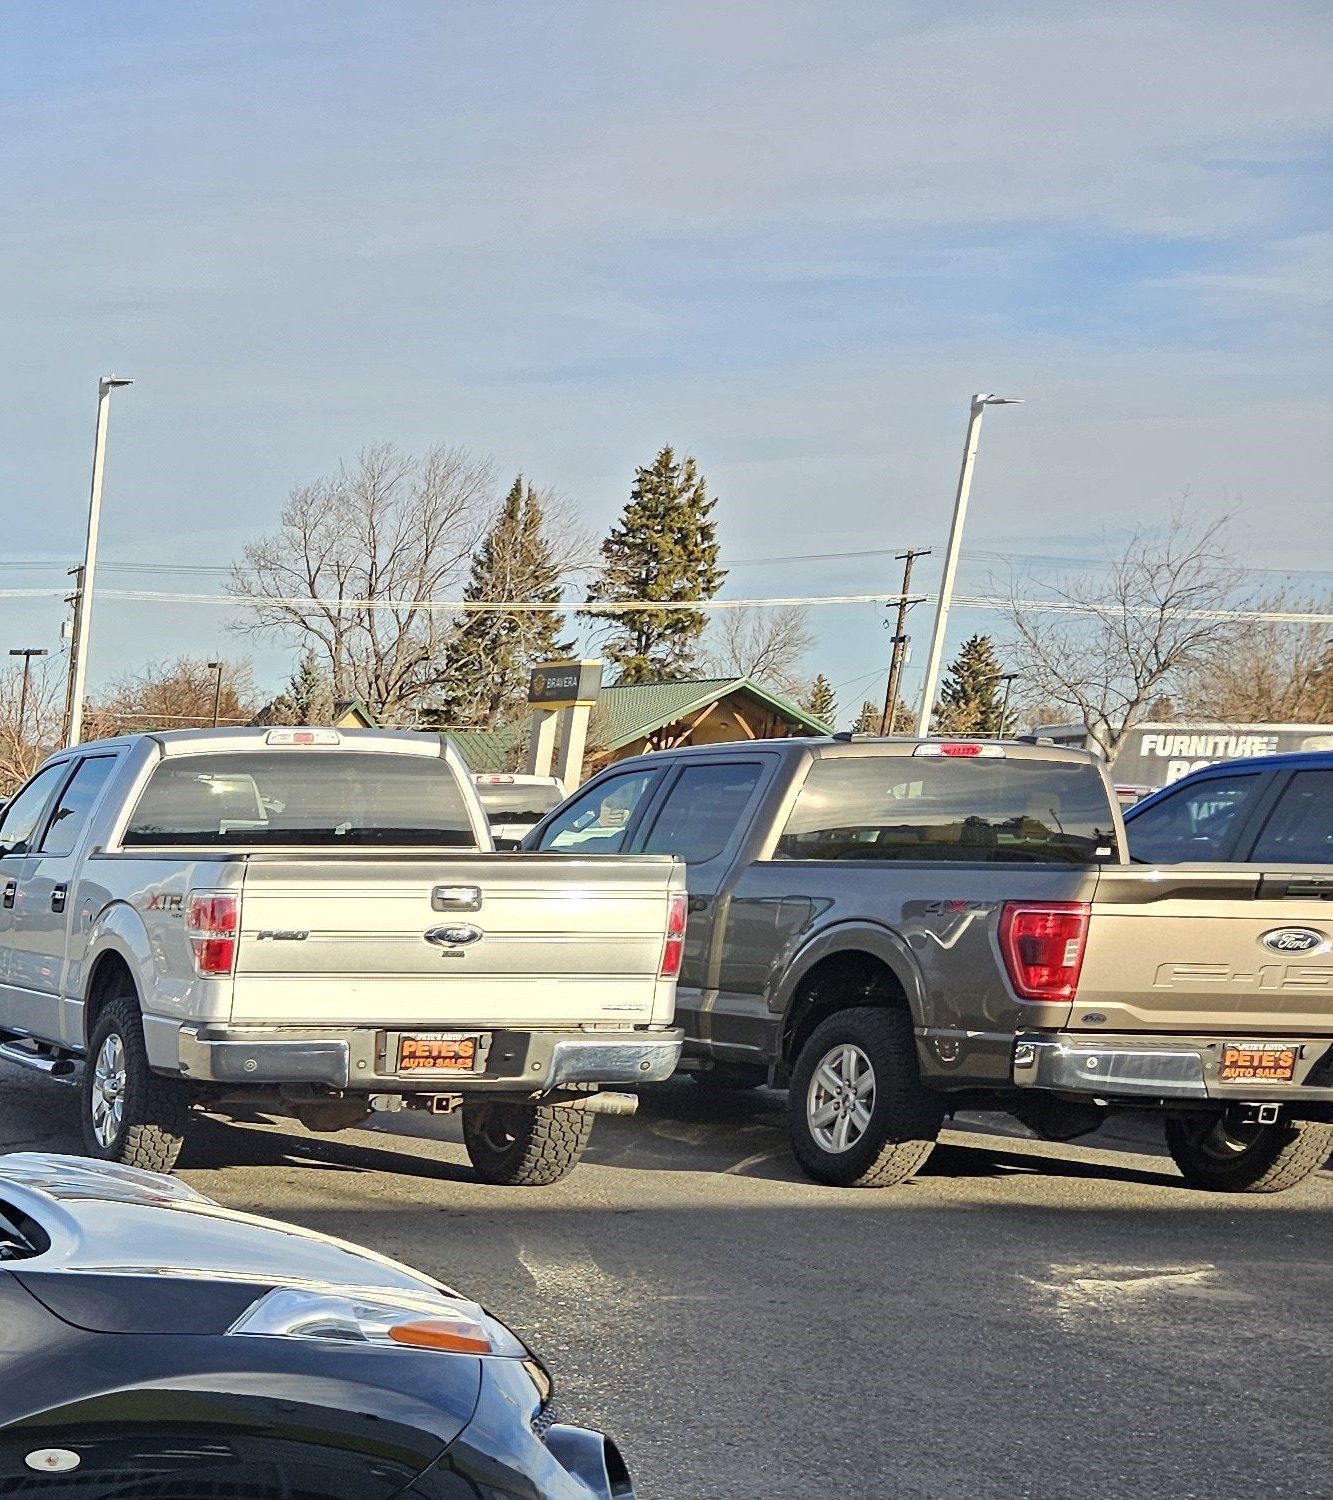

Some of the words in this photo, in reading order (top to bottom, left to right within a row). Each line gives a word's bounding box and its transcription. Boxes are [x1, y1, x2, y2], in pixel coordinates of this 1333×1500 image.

[546, 677, 578, 689] BRAVERA
[146, 893, 183, 911] XTR
[1277, 933, 1311, 950] Ford
[402, 1040, 473, 1057] PETE'S
[400, 1057, 434, 1069] AUTO
[435, 1057, 473, 1069] SALES
[1224, 1050, 1293, 1067] PETE'S
[1221, 1067, 1254, 1078] AUTO
[1255, 1067, 1292, 1078] SALES
